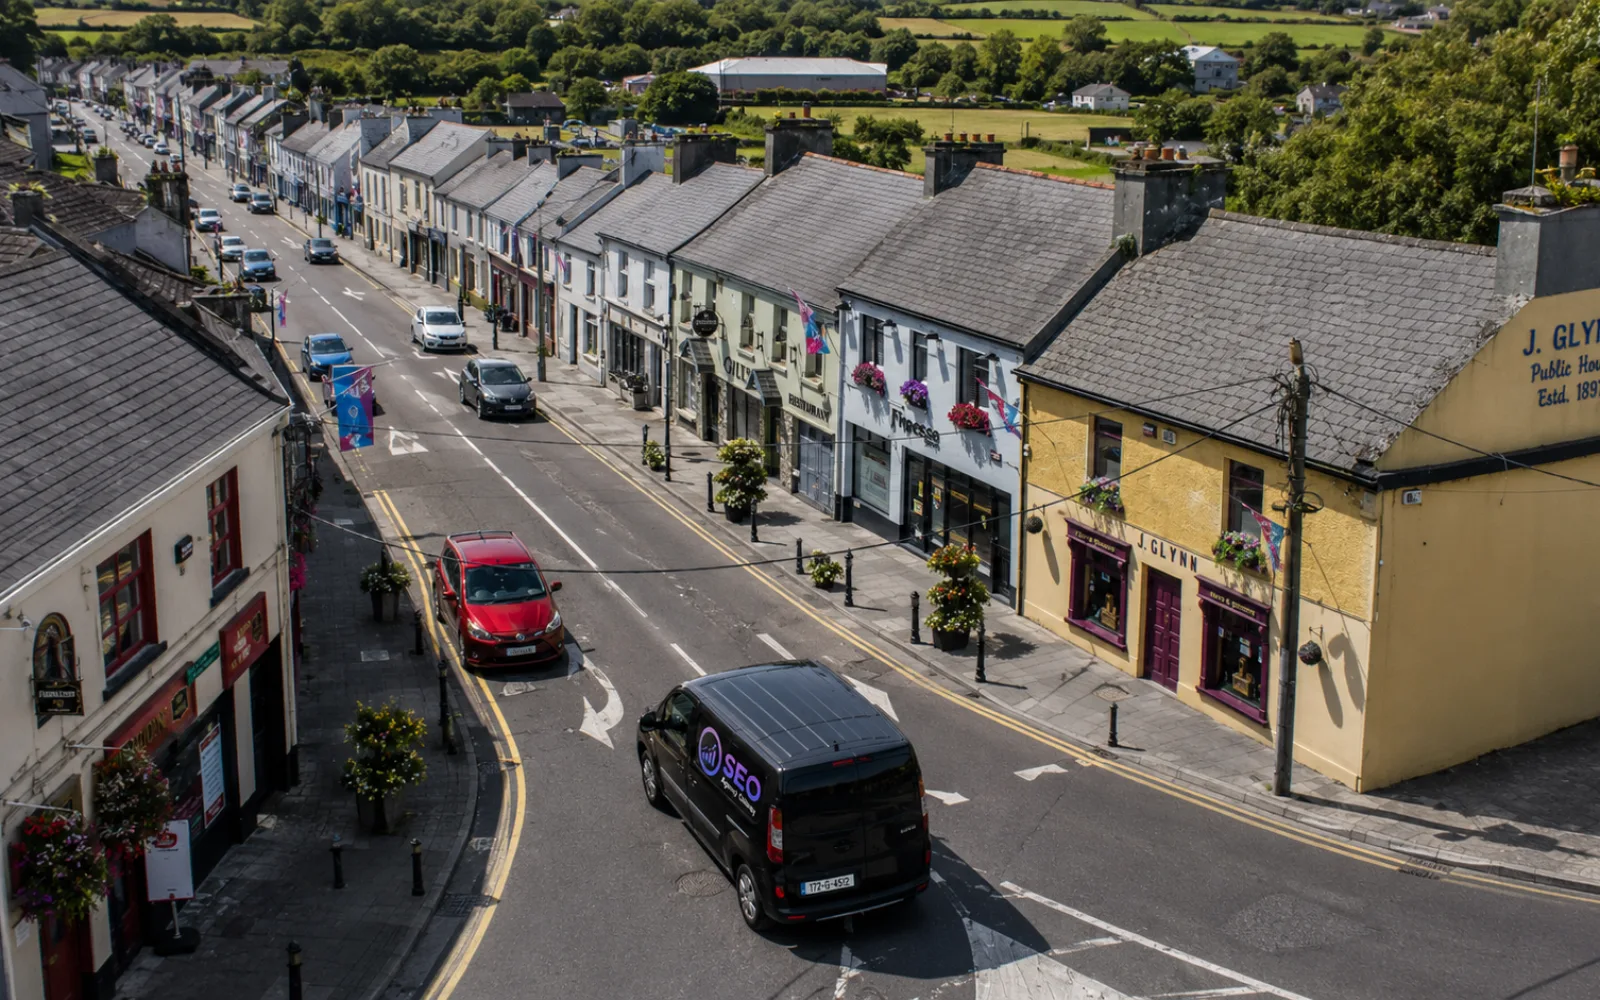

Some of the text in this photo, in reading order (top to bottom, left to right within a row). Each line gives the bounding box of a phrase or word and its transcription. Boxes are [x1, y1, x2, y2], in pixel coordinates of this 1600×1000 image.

[1522, 318, 1600, 356] J. GLY
[1530, 359, 1572, 383] Public
[1537, 384, 1569, 407] Estd.
[1137, 532, 1147, 551] J.
[1151, 538, 1198, 573] GLYNN
[723, 753, 762, 802] SEO
